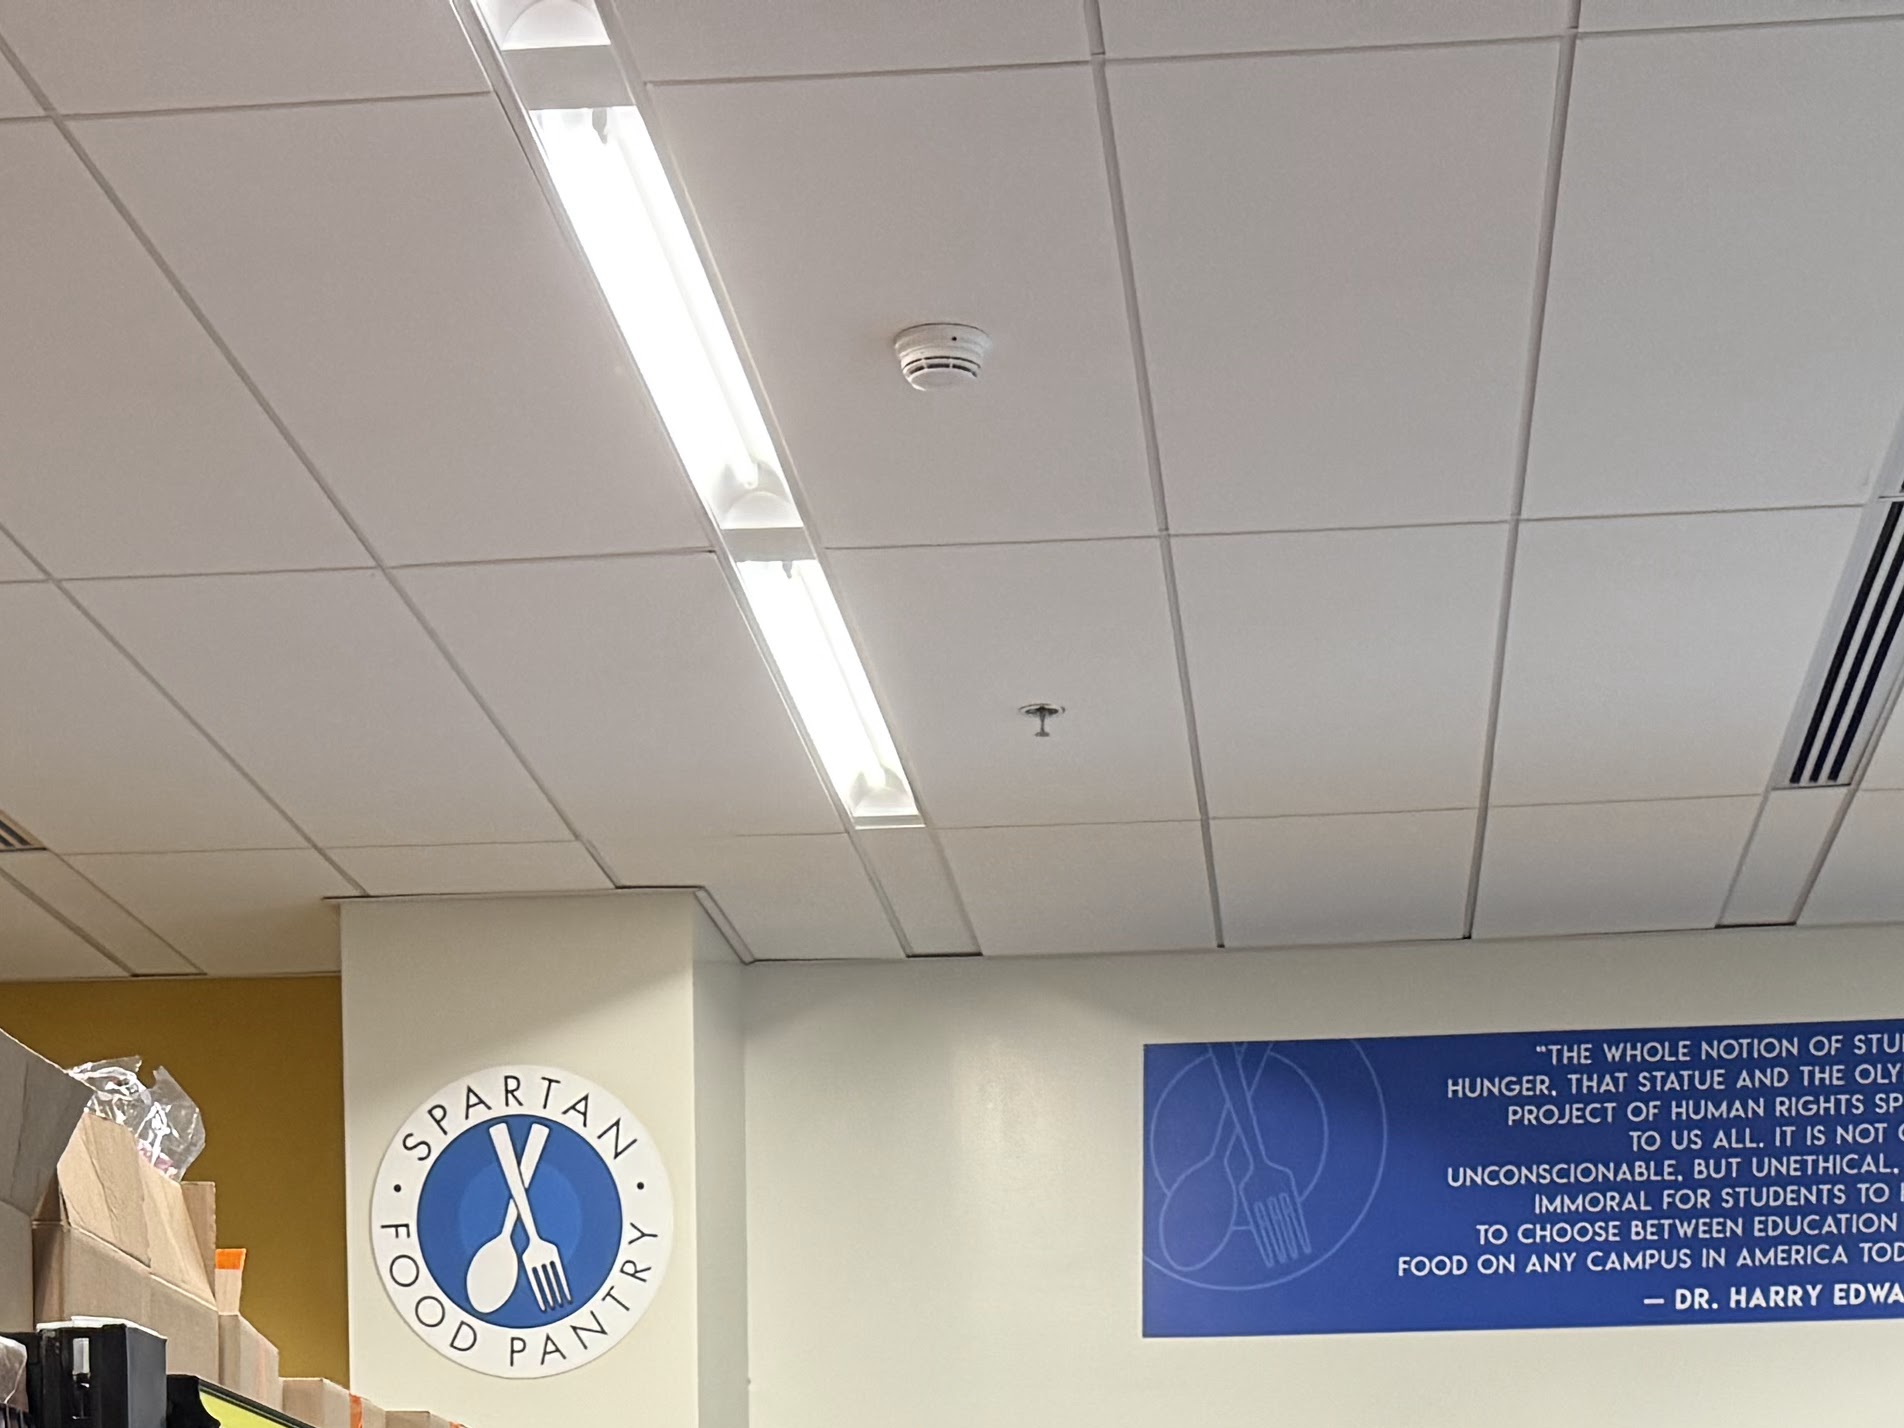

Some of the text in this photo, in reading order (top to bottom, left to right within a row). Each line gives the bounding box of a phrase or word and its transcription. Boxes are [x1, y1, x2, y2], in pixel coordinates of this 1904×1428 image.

[1604, 1041, 1691, 1062] WHOLE
[1701, 1037, 1798, 1060] NOTION
[1809, 1036, 1843, 1056] OF
[1568, 1072, 1628, 1095] THAT
[1638, 1069, 1726, 1092] STATUE
[1736, 1068, 1789, 1089] AND
[1800, 1066, 1845, 1086] THE
[402, 1074, 638, 1162] SPARTAN
[1508, 1102, 1616, 1125] PROJECT
[1627, 1101, 1661, 1122] OF
[1671, 1098, 1764, 1120] HUMAN
[1775, 1095, 1864, 1117] RIGHTS
[1629, 1131, 1661, 1152] TO
[1671, 1130, 1702, 1151] US
[1713, 1129, 1764, 1149] ALL.
[1775, 1127, 1795, 1146] IT
[1806, 1126, 1825, 1145] IS
[1837, 1124, 1887, 1144] NOT
[1694, 1158, 1741, 1179] BUT
[1534, 1191, 1652, 1214] IMMORAL
[1663, 1189, 1711, 1210] FOR
[1721, 1185, 1846, 1208] STUDENTS
[1857, 1183, 1890, 1203] TO
[1476, 1224, 1508, 1245] TO
[1517, 1221, 1621, 1243] CHOOSE
[1631, 1218, 1743, 1241] BETWEEN
[1754, 1213, 1896, 1236] EDUCATION
[1398, 1256, 1468, 1276] FOOD
[1477, 1254, 1515, 1274] ON
[1526, 1252, 1576, 1273] ANY
[1587, 1248, 1691, 1271] CAMPUS
[1701, 1248, 1726, 1268] IN
[1736, 1245, 1848, 1267] AMERICA
[380, 1222, 658, 1367] FOOD PANTRY
[1675, 1288, 1718, 1310] DR.
[1729, 1284, 1823, 1308] HARRY
